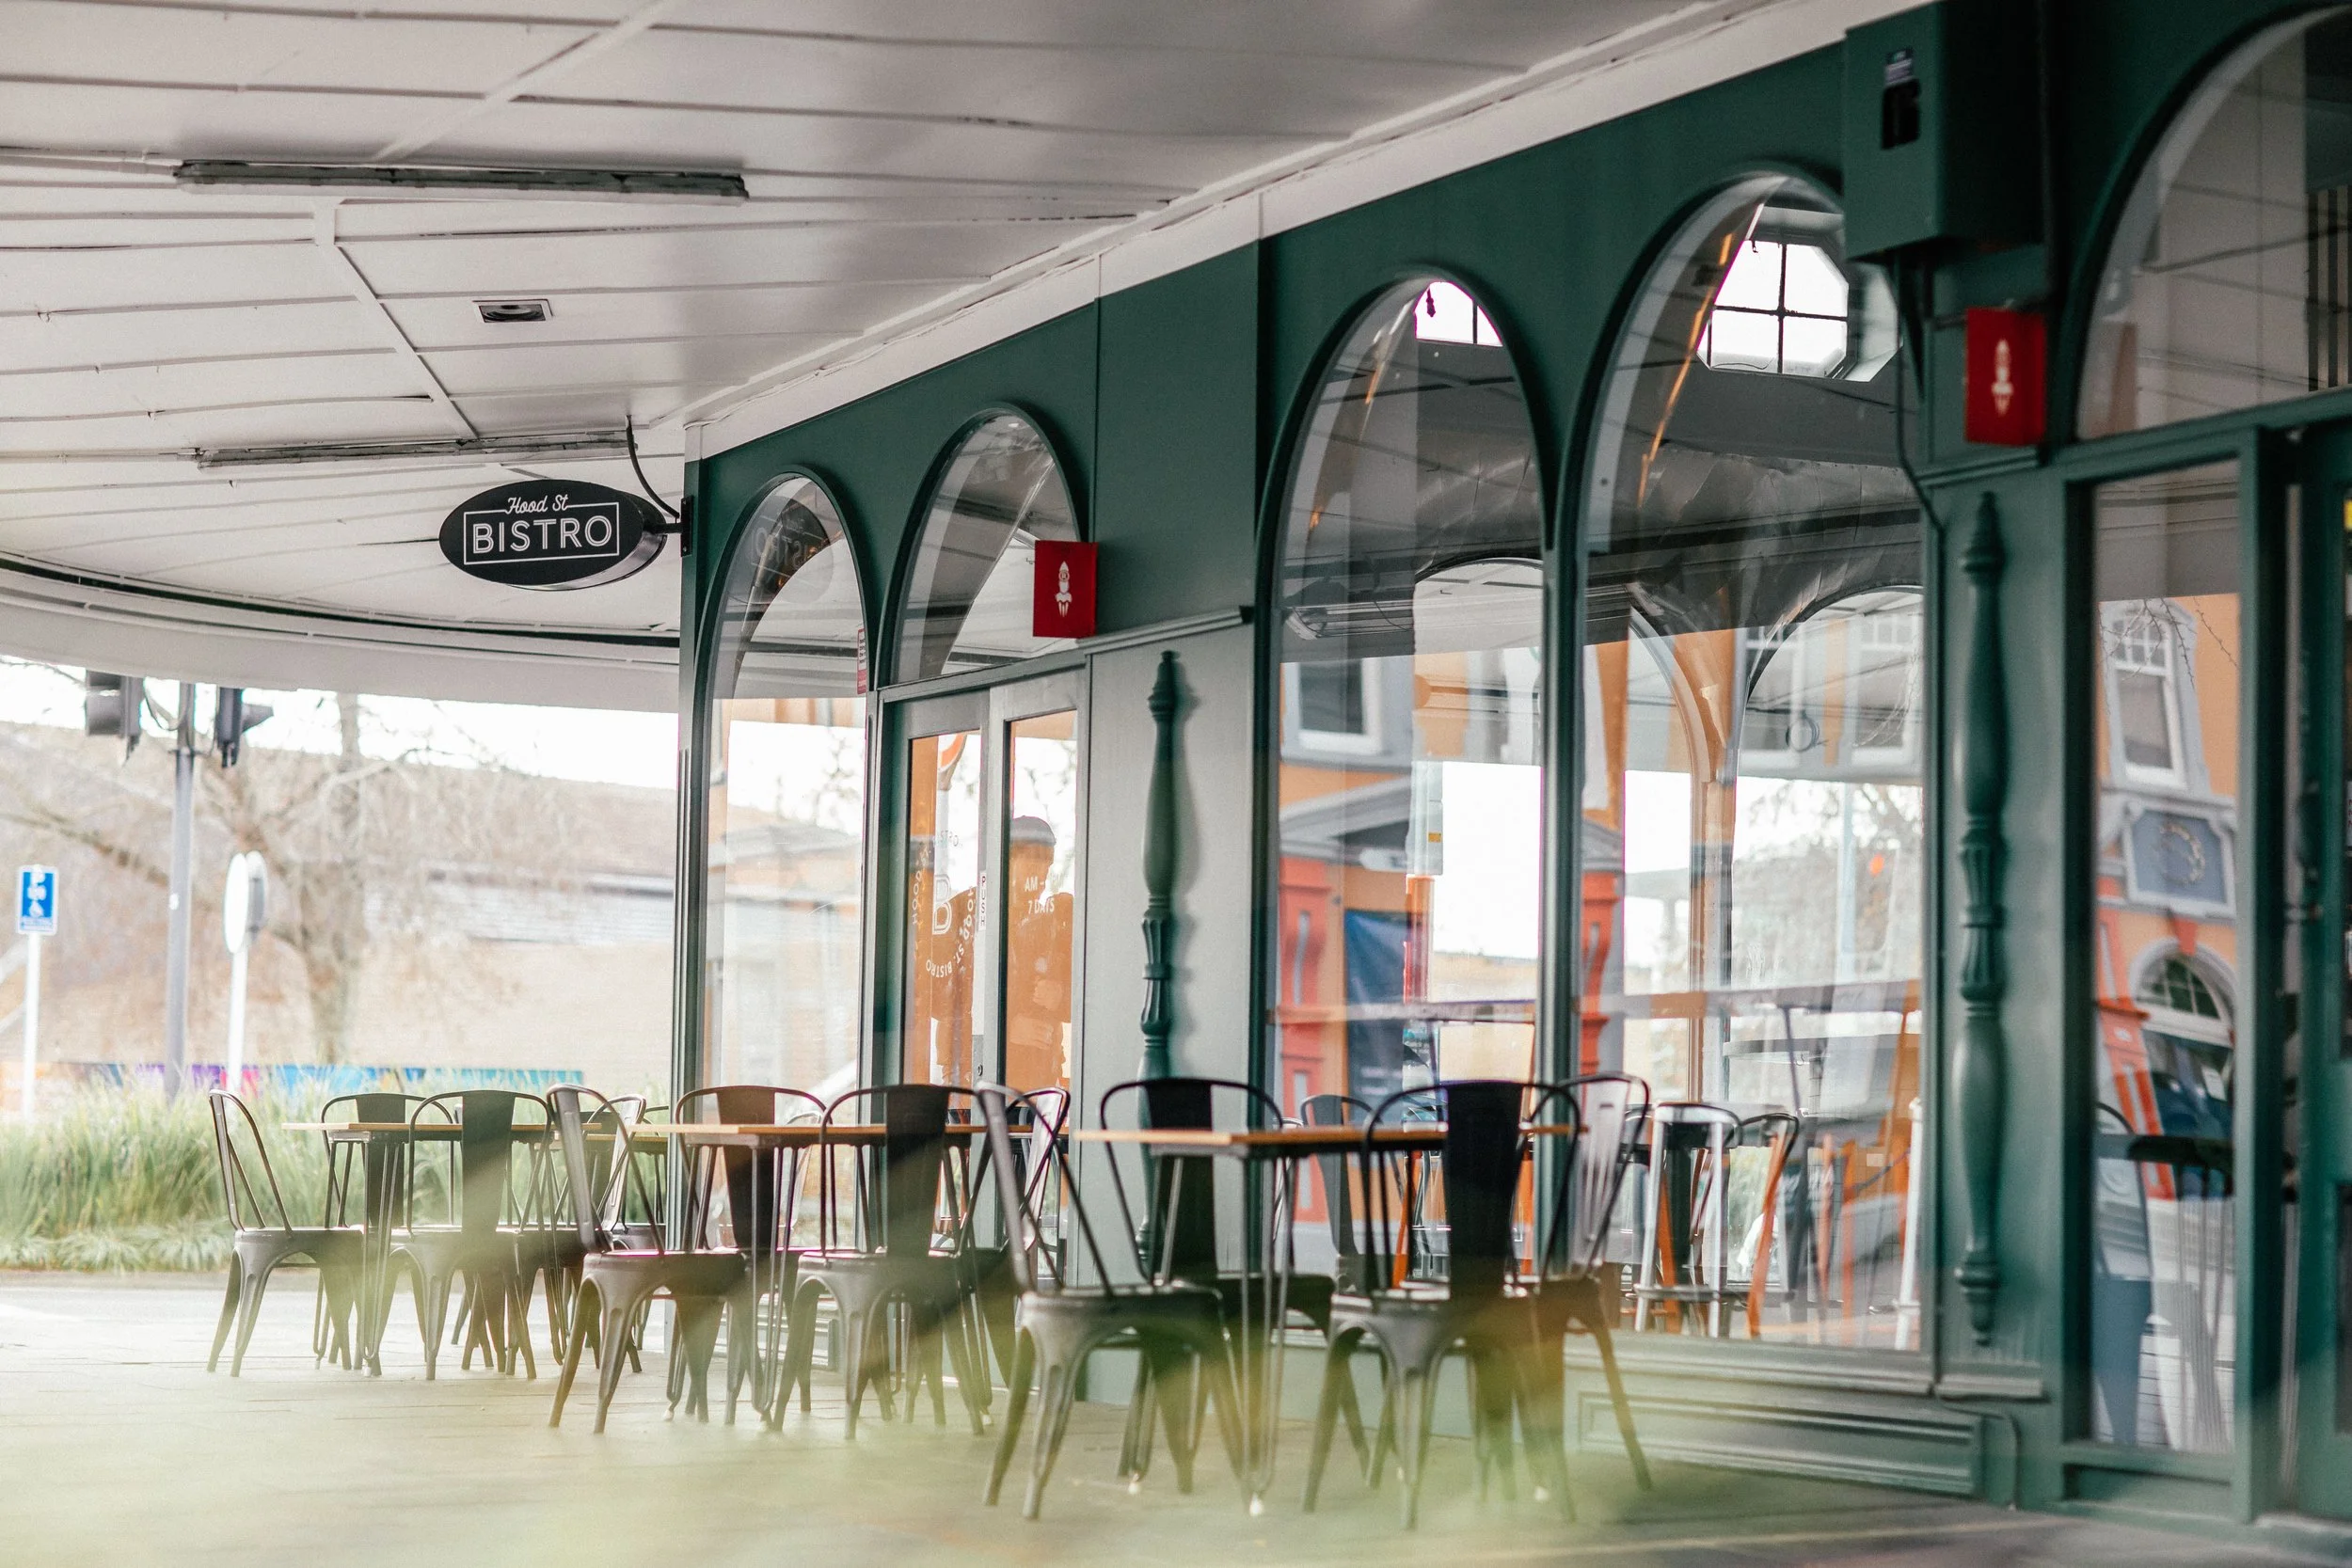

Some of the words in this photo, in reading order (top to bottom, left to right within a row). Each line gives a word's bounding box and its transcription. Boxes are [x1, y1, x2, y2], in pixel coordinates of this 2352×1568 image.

[505, 495, 548, 515] Hood
[552, 494, 568, 512] St
[473, 515, 612, 554] BISTRO
[1028, 900, 1033, 914] 7
[926, 959, 952, 978] BISTRO
